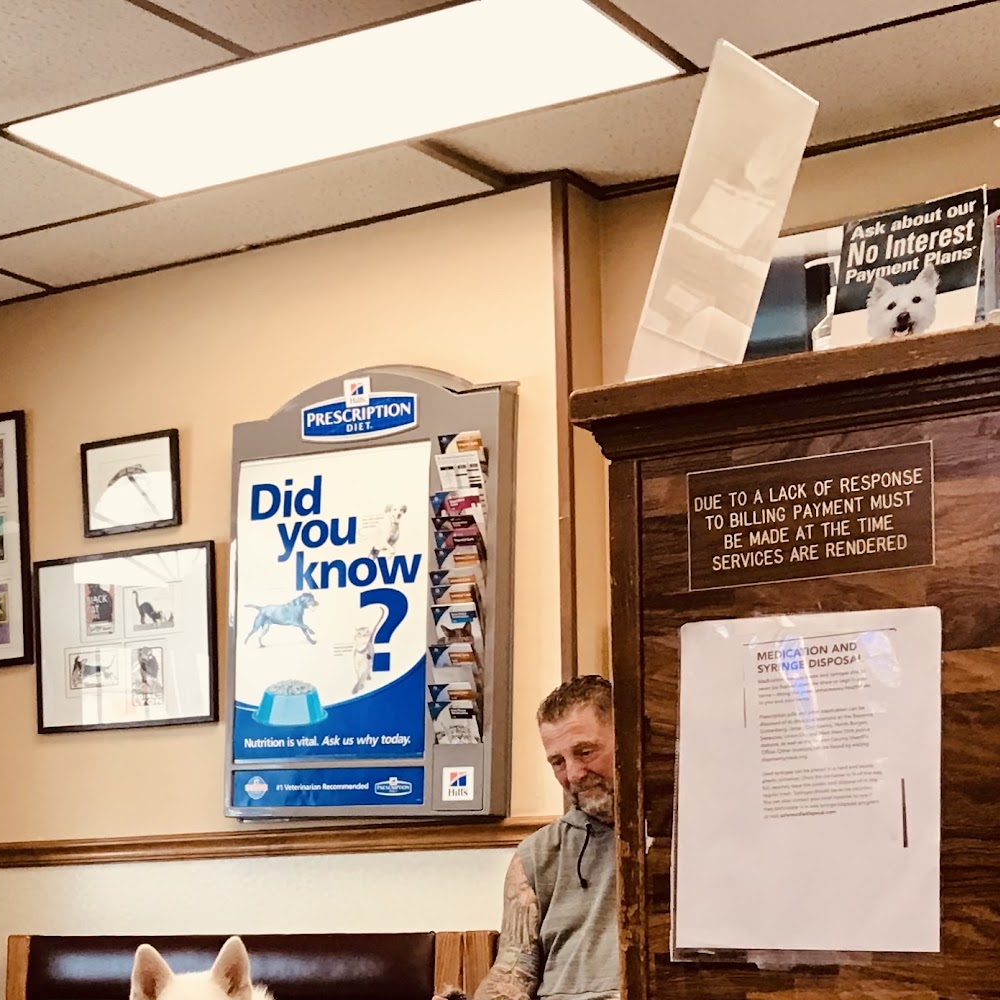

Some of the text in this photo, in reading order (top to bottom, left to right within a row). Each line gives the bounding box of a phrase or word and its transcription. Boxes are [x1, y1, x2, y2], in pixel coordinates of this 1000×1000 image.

[850, 199, 977, 241] Ask about our
[846, 218, 976, 268] No Interest
[845, 257, 920, 285] Payment
[306, 401, 412, 428] PRESCRIPTION
[250, 475, 322, 521] Did
[694, 468, 923, 513] DUE TO A LACK OF RESPONSE
[705, 490, 914, 531] TO BILLING PAYMENT MUST
[277, 516, 357, 563] you
[723, 514, 894, 550] BE MADE AT THE TIME
[296, 551, 422, 591] know
[712, 534, 908, 572] SERVICES ARE RENDERED
[832, 642, 858, 654] AND
[757, 660, 805, 674] SYRNGE
[244, 733, 411, 749] Nutrition is vital. Ask us why today.
[284, 783, 321, 791] Veterinarian
[322, 782, 370, 791] Recommended
[448, 787, 469, 797] Hill's
